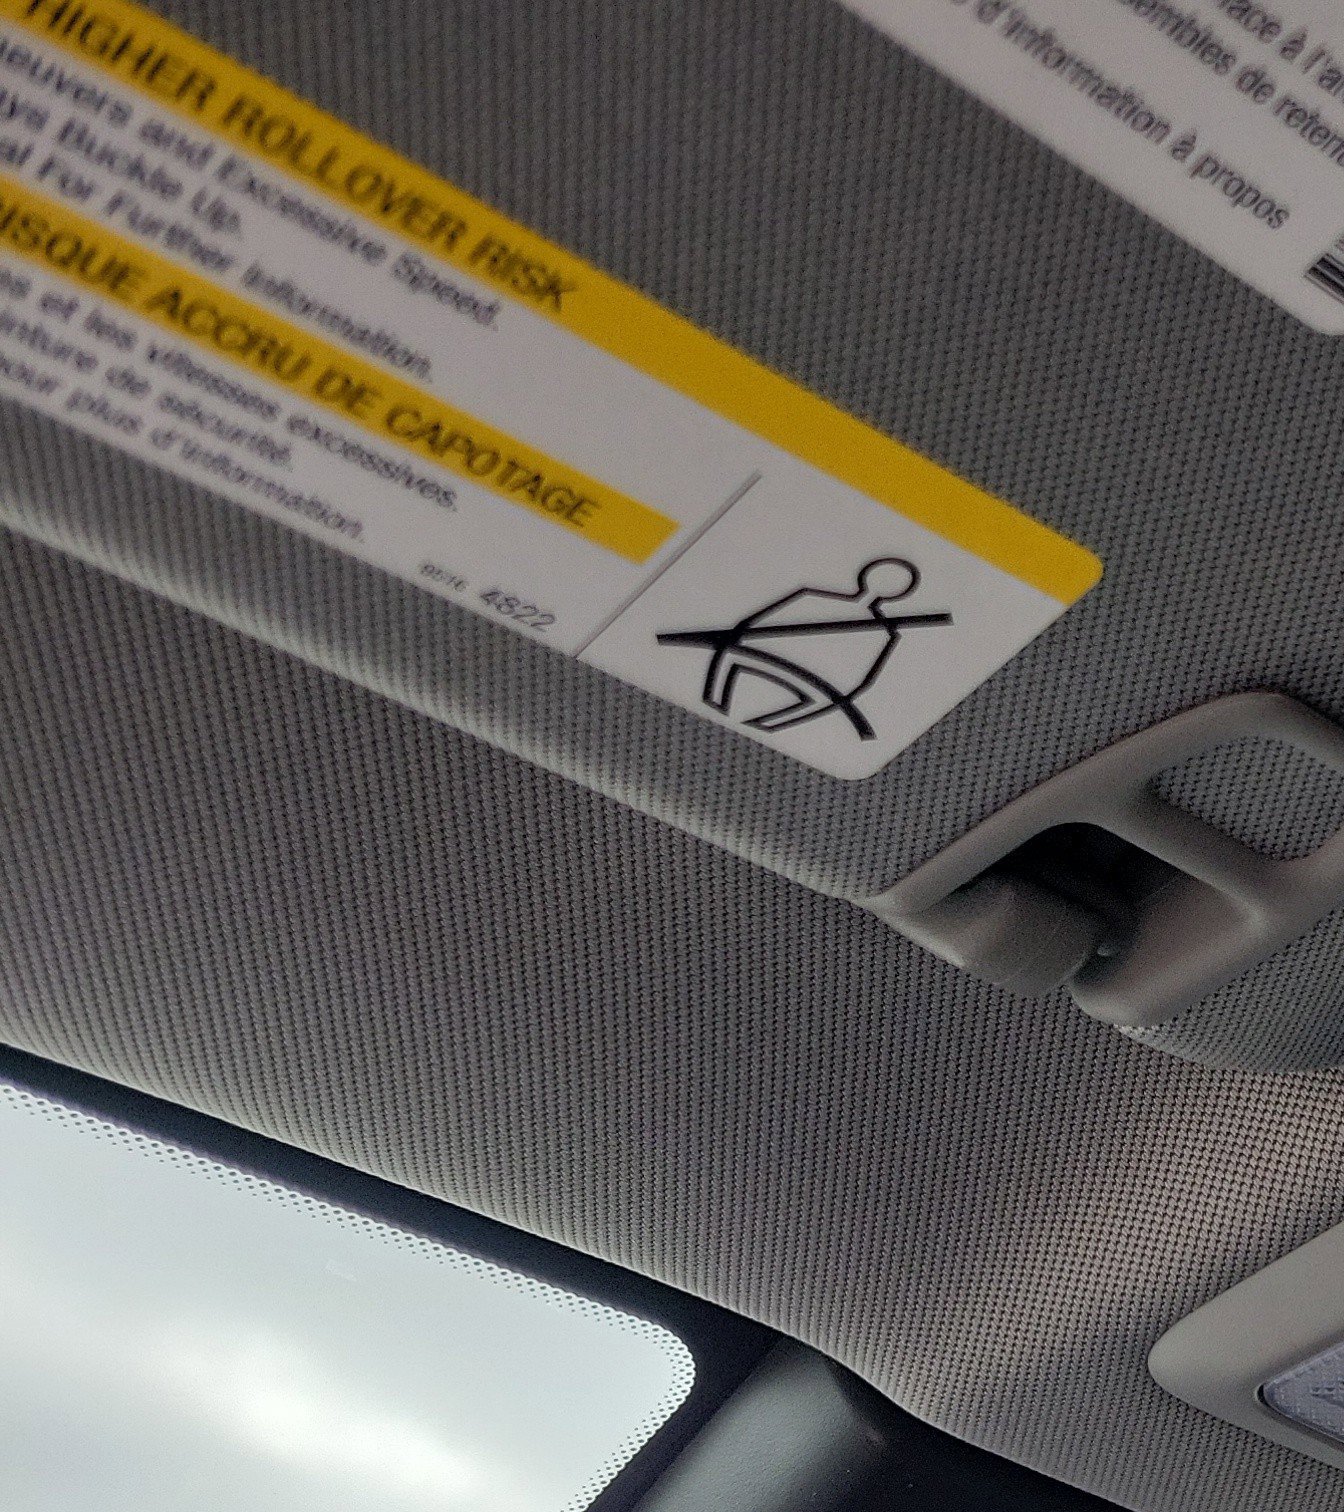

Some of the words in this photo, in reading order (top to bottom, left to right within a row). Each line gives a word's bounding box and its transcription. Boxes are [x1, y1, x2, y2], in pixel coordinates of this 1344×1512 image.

[1278, 25, 1309, 63] à
[1235, 63, 1277, 105] de
[37, 153, 96, 201] For
[139, 119, 215, 170] and
[214, 155, 387, 267] Excessive
[222, 95, 469, 252] ROLLOVER
[467, 233, 577, 311] RISK
[1169, 126, 1198, 163] à
[1189, 149, 1291, 231] propos
[0, 199, 147, 303] ISQUE
[146, 284, 313, 383] ACCRU
[312, 366, 382, 418] DE
[385, 403, 602, 528] CAPOTAGE
[480, 585, 556, 632] 4822
